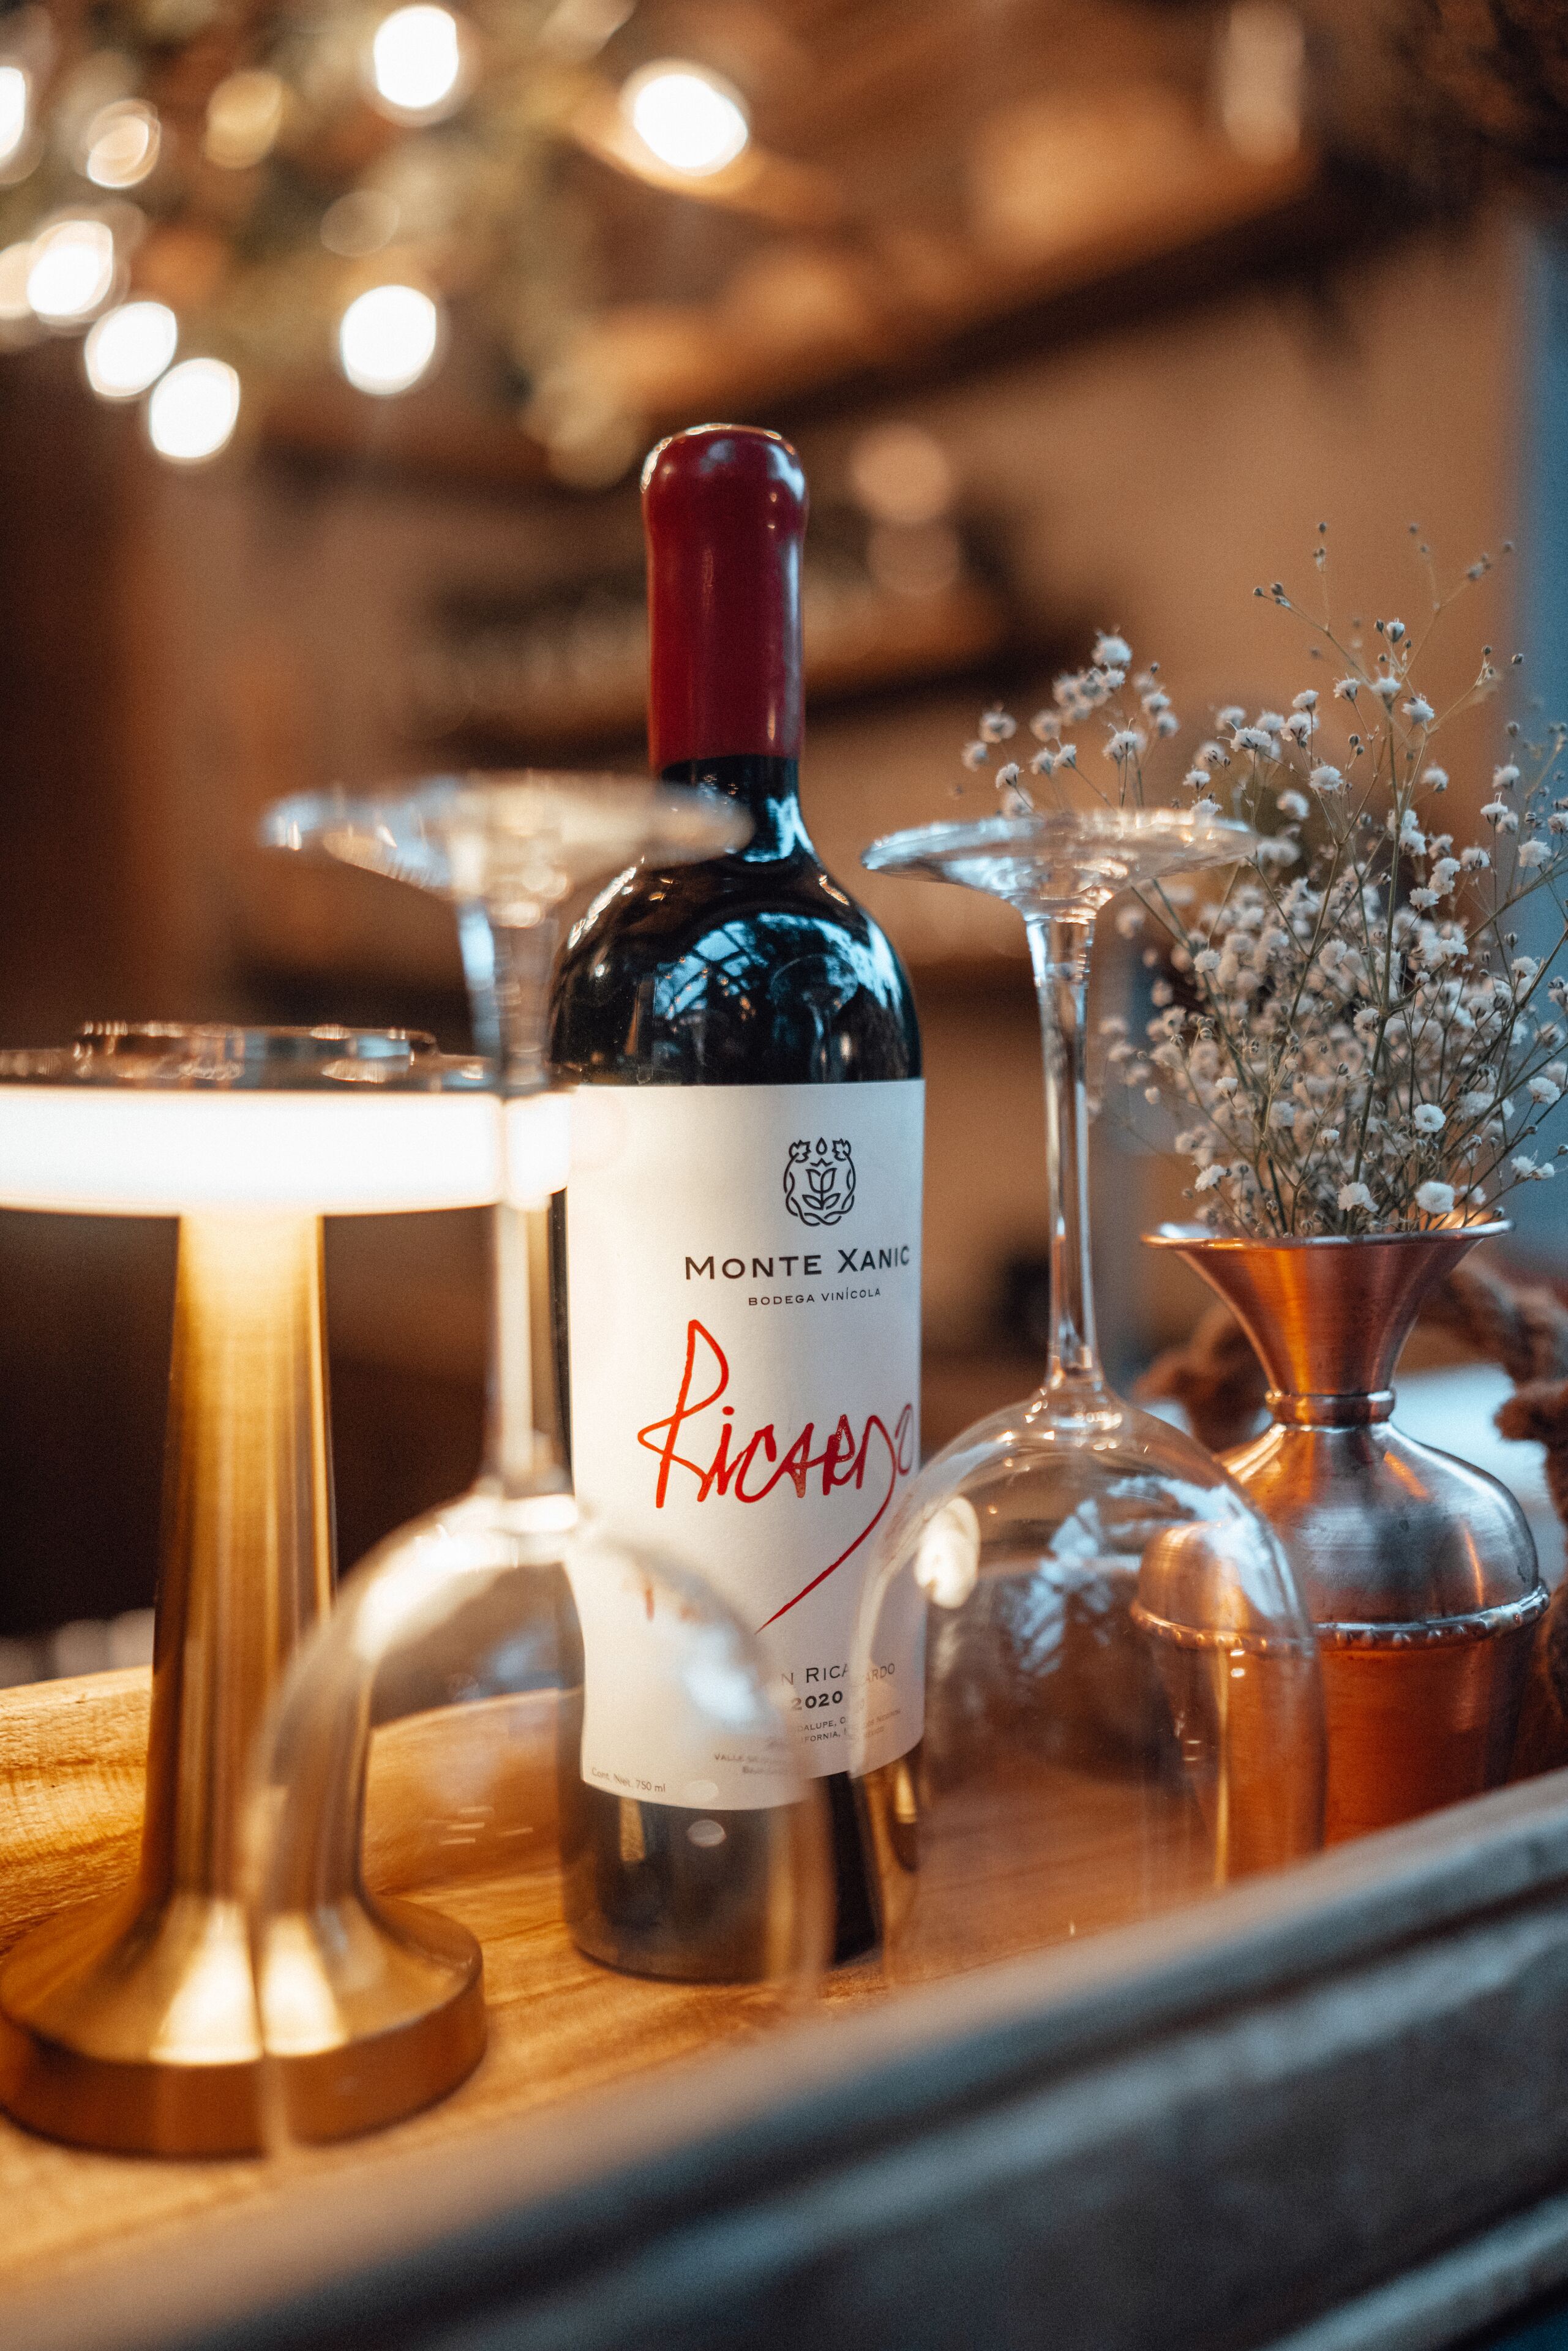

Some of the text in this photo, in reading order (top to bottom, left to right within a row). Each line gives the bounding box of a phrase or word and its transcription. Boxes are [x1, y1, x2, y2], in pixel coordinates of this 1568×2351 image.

[685, 1245, 910, 1280] MONTE XANIC
[748, 1287, 881, 1306] BODEGA VINÍCOLA
[791, 1690, 843, 1711] 2020
[798, 1720, 837, 1732] DALUPE,
[636, 1779, 652, 1791] 750
[654, 1783, 666, 1793] ml
